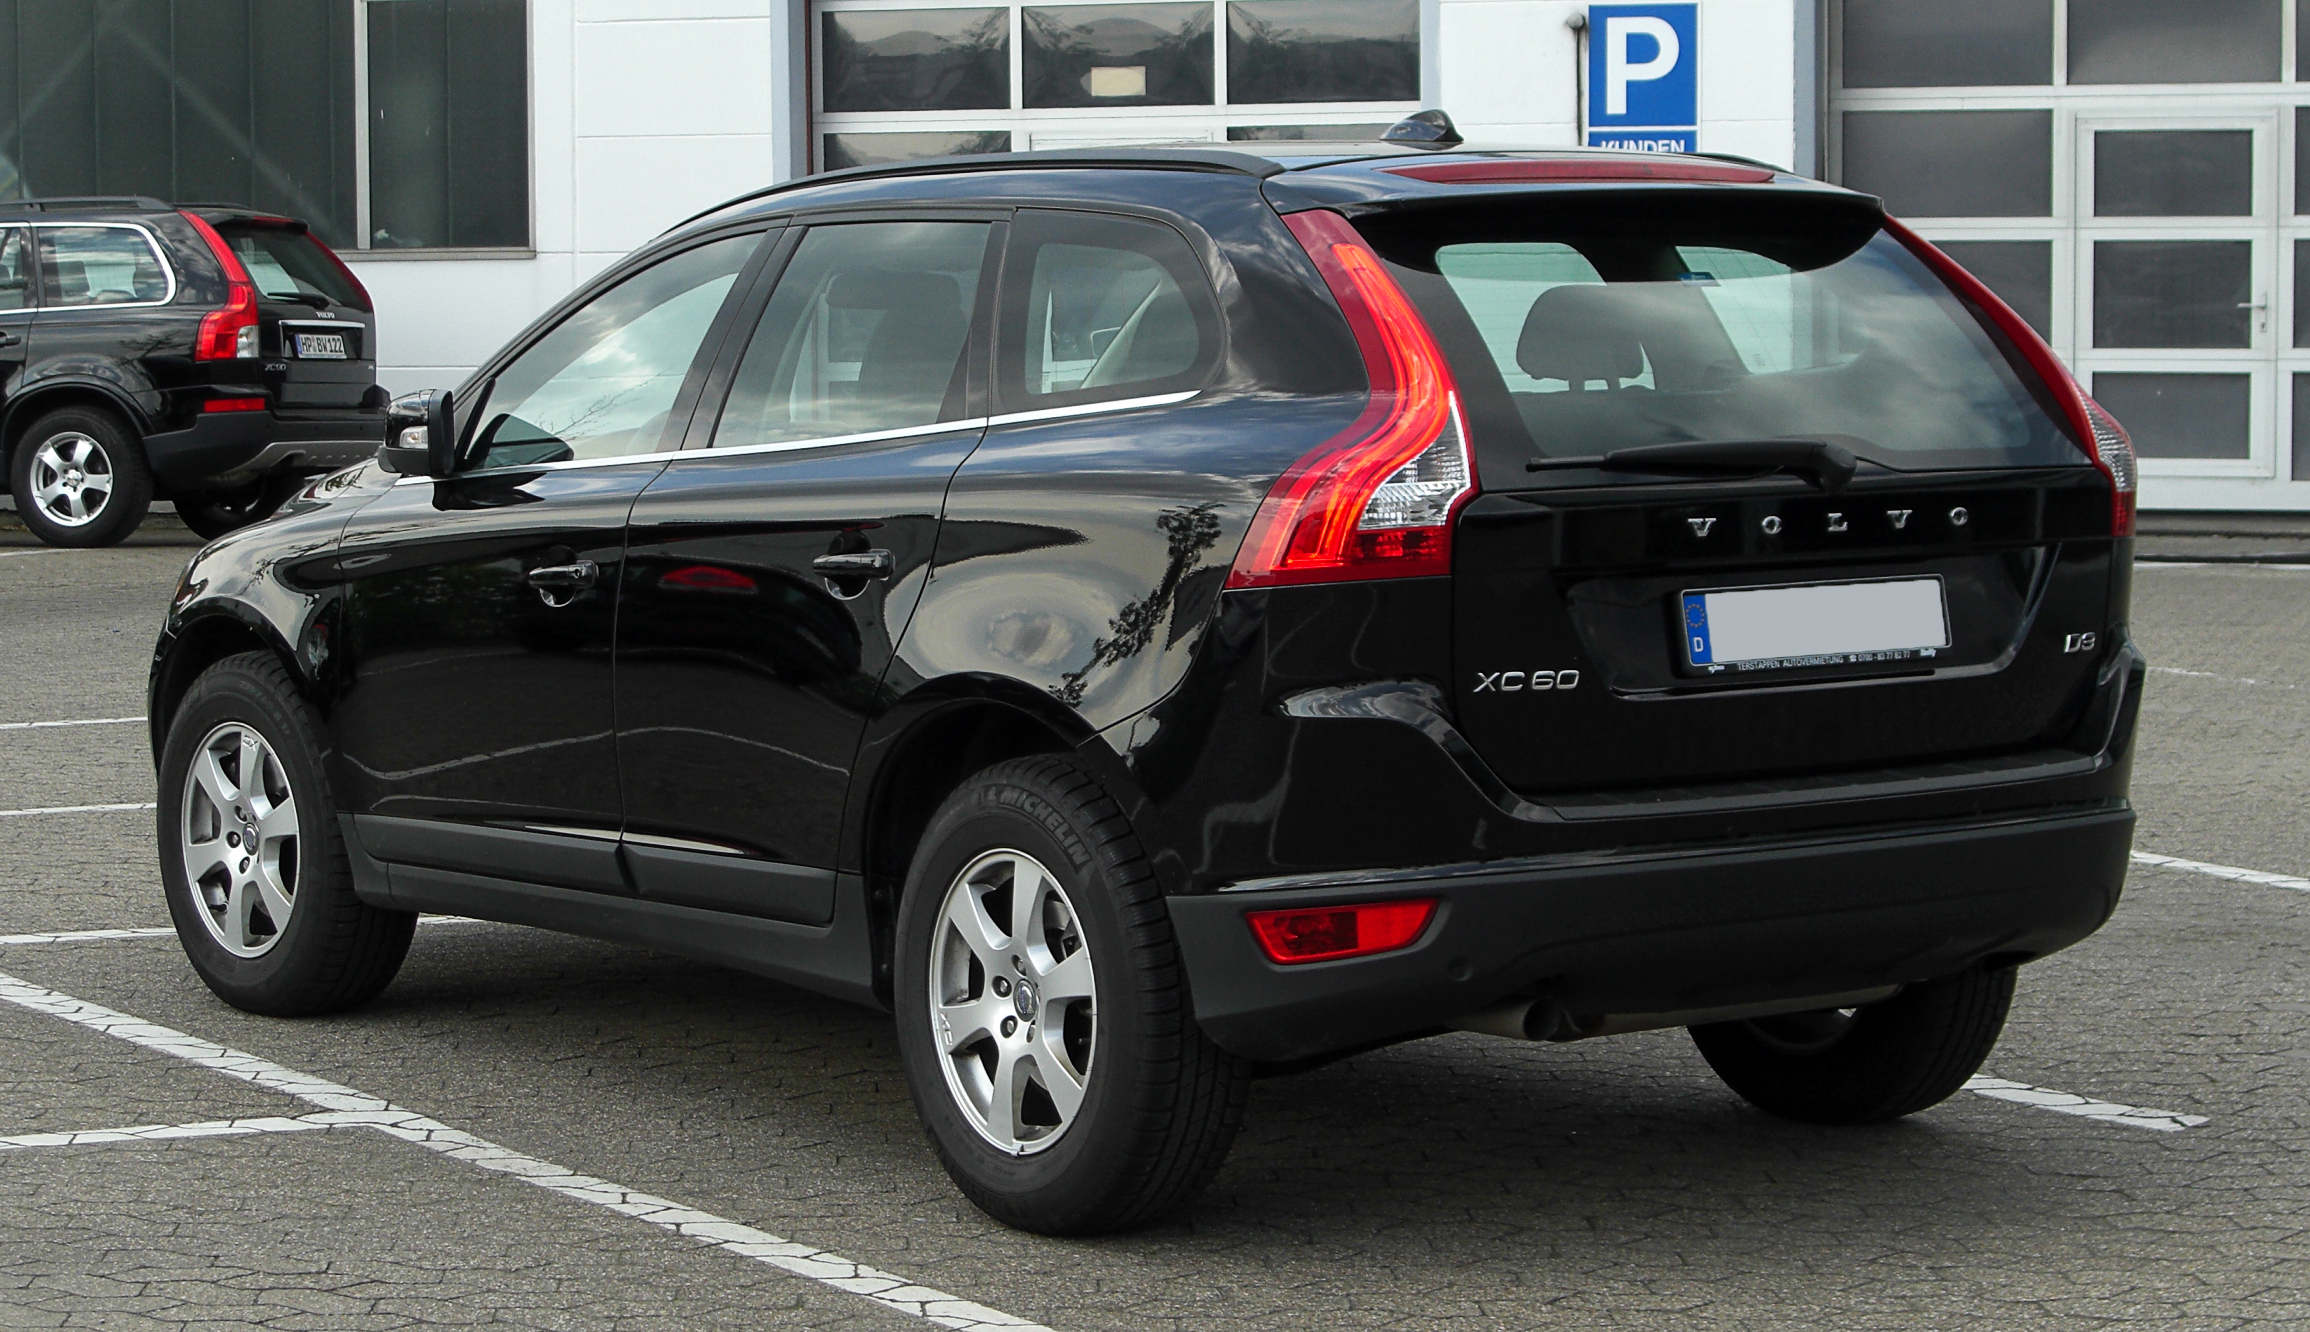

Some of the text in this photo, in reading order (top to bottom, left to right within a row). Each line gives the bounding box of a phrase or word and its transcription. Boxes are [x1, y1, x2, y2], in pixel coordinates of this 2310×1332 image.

[1606, 16, 1680, 115] P
[1687, 506, 1969, 537] VOLVO
[1693, 636, 1704, 652] D
[2064, 631, 2096, 652] D3
[1782, 654, 1844, 668] AUTOVERMIETUNG
[999, 785, 1092, 865] MICHELIN
